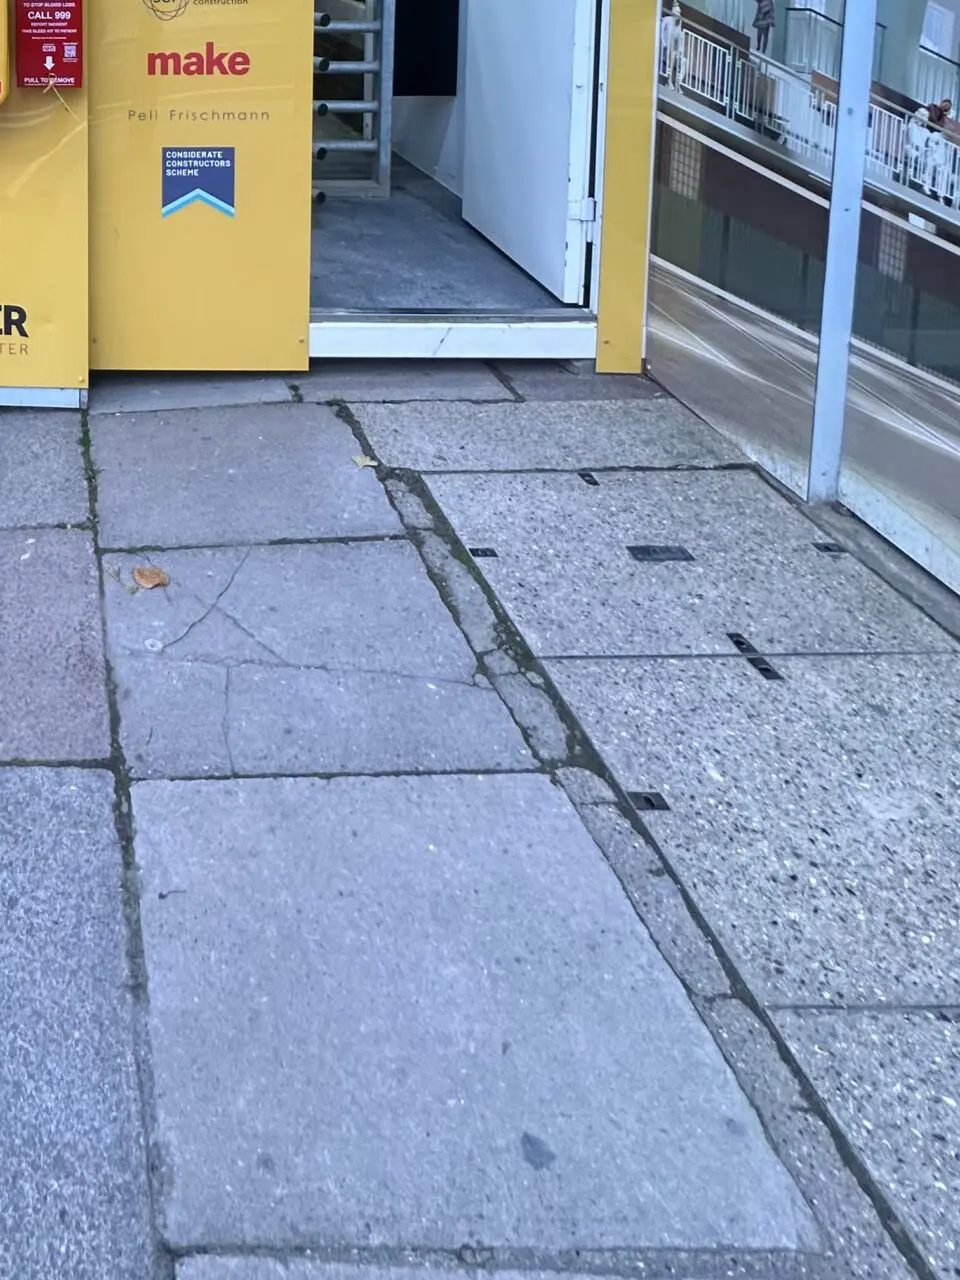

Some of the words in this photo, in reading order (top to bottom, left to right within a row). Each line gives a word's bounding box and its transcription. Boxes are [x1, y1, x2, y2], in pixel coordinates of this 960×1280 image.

[27, 11, 53, 20] CALL
[54, 11, 72, 20] 999
[147, 42, 251, 76] make
[23, 76, 40, 84] PULL
[50, 76, 75, 84] EMOVE
[128, 109, 158, 121] Pell
[169, 108, 270, 121] Frischmann
[165, 151, 224, 159] CONSIDERATE
[165, 168, 200, 176] SCHEME
